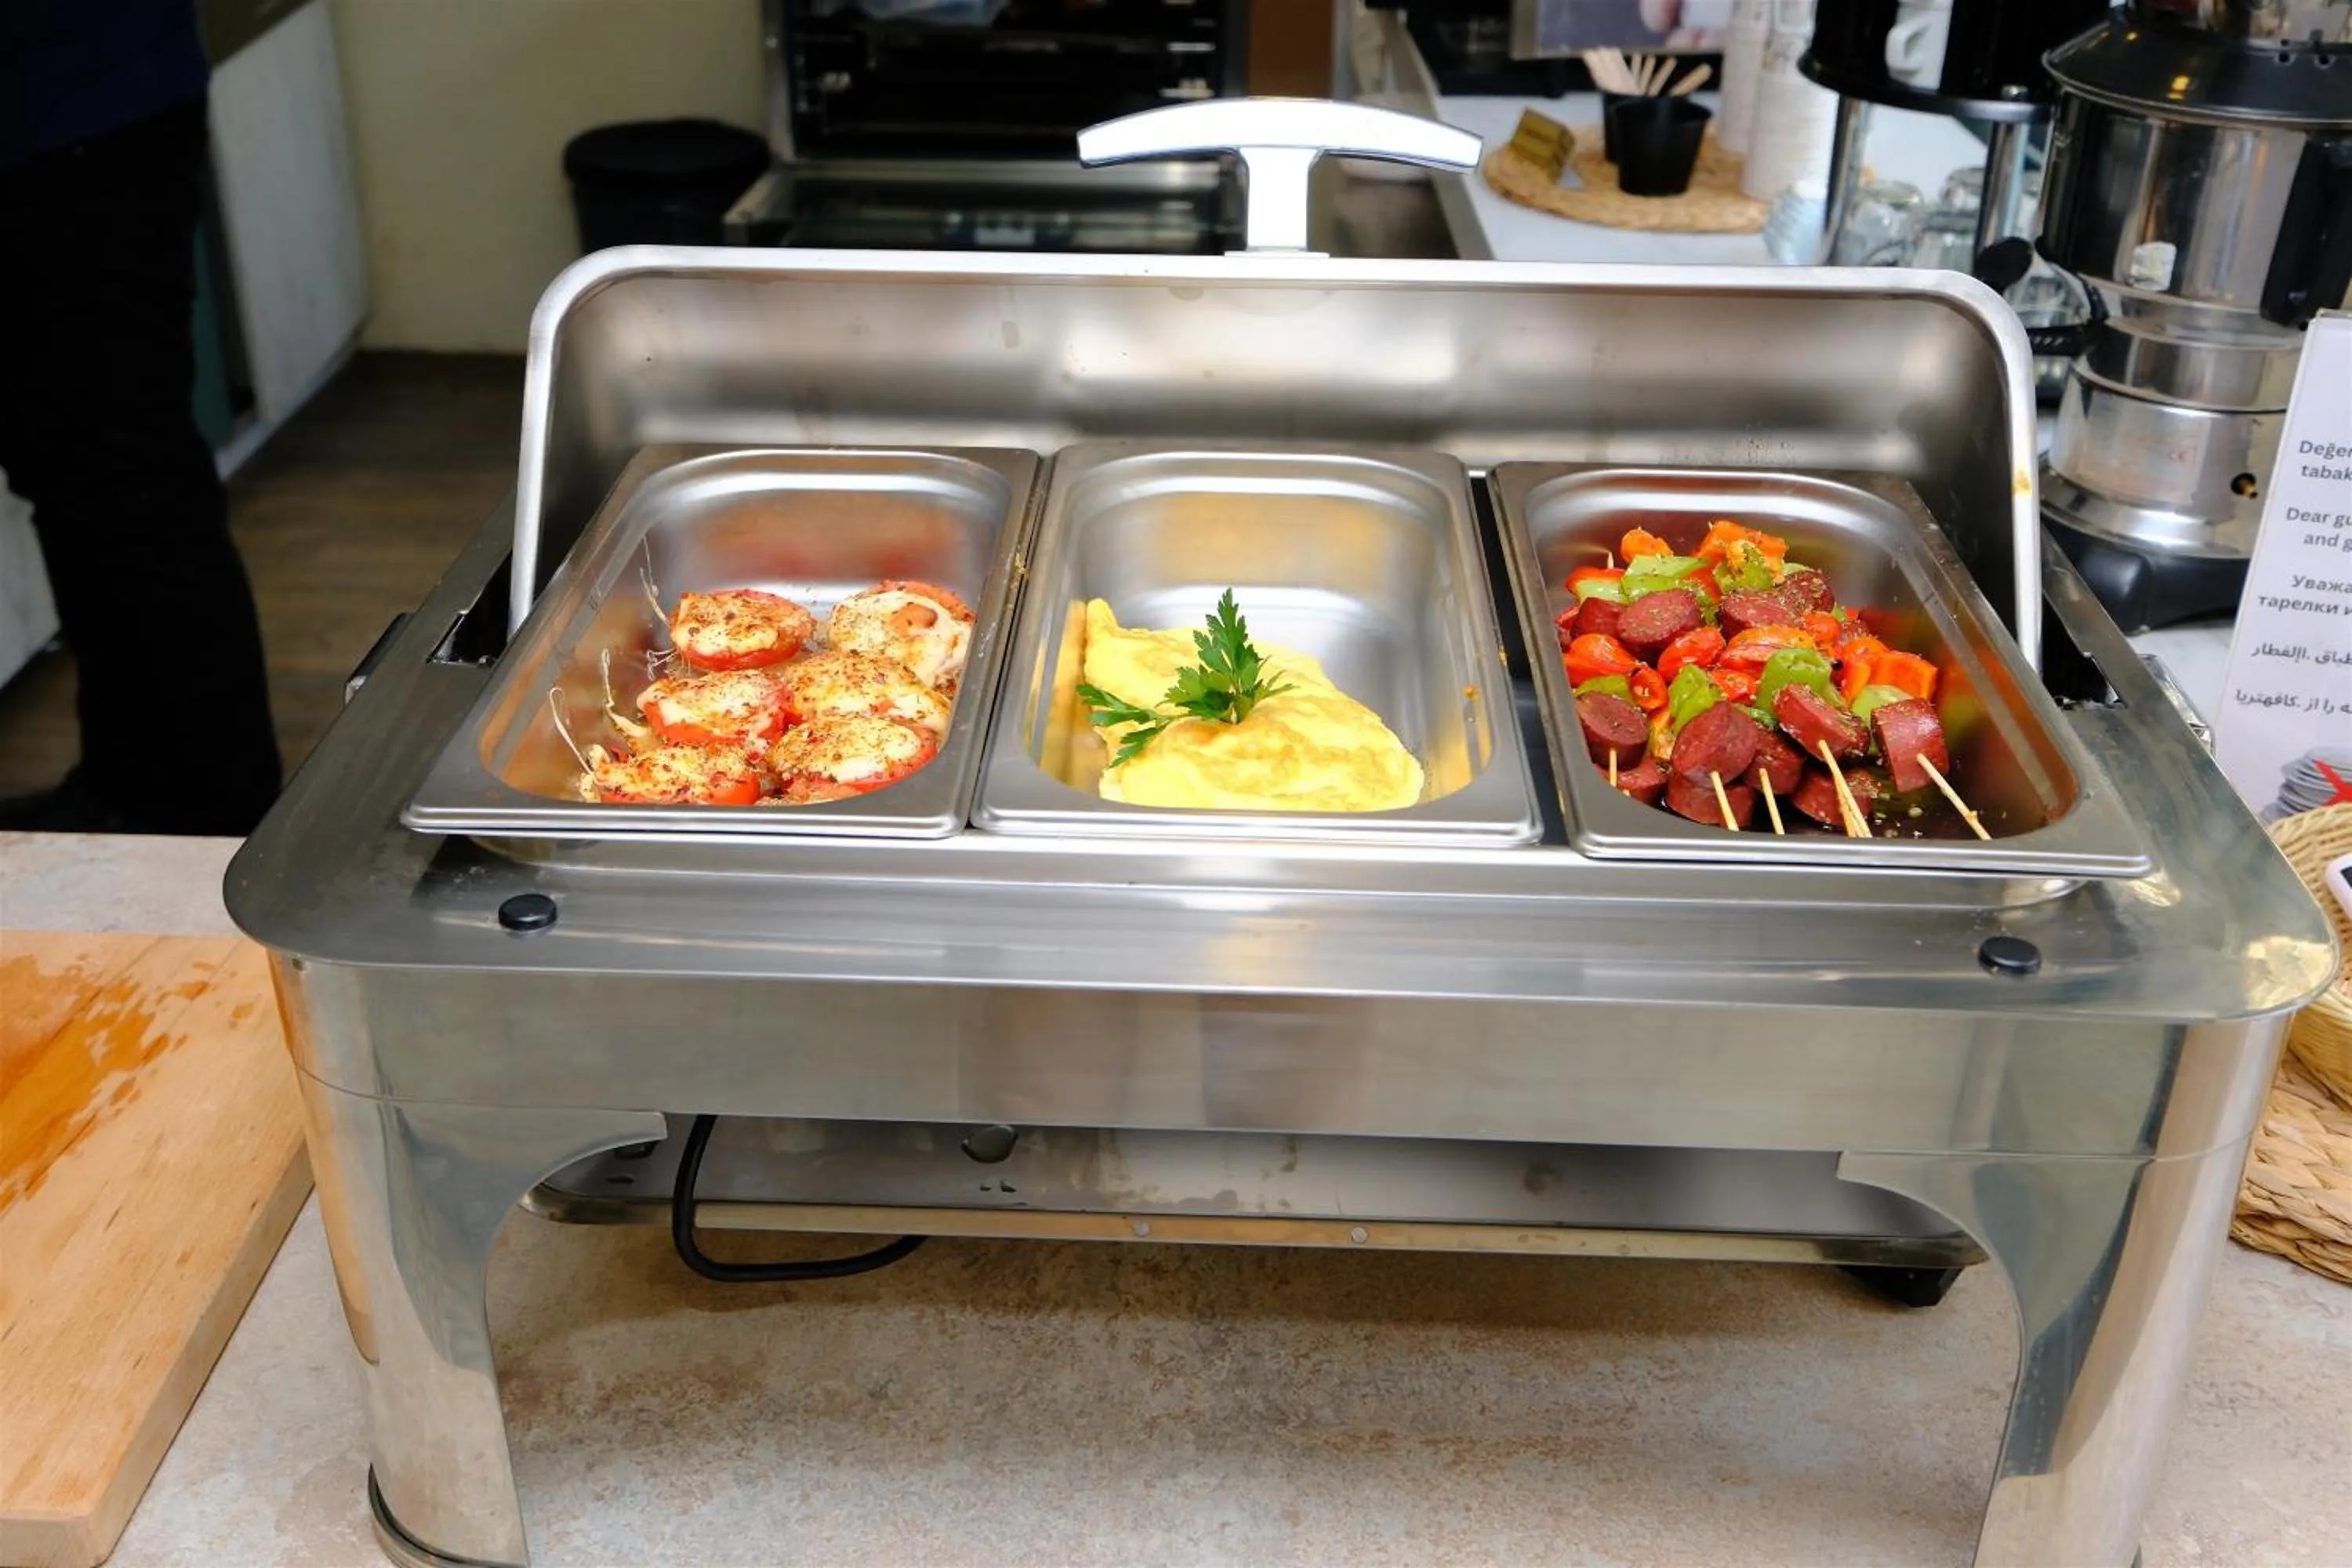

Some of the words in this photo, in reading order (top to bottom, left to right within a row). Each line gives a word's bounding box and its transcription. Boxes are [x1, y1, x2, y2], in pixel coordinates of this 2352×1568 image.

[2301, 464, 2352, 481] tabak
[2286, 506, 2330, 524] Dear
[2303, 534, 2339, 547] and
[2291, 574, 2352, 594] Уважа
[2258, 596, 2339, 615] тарелки
